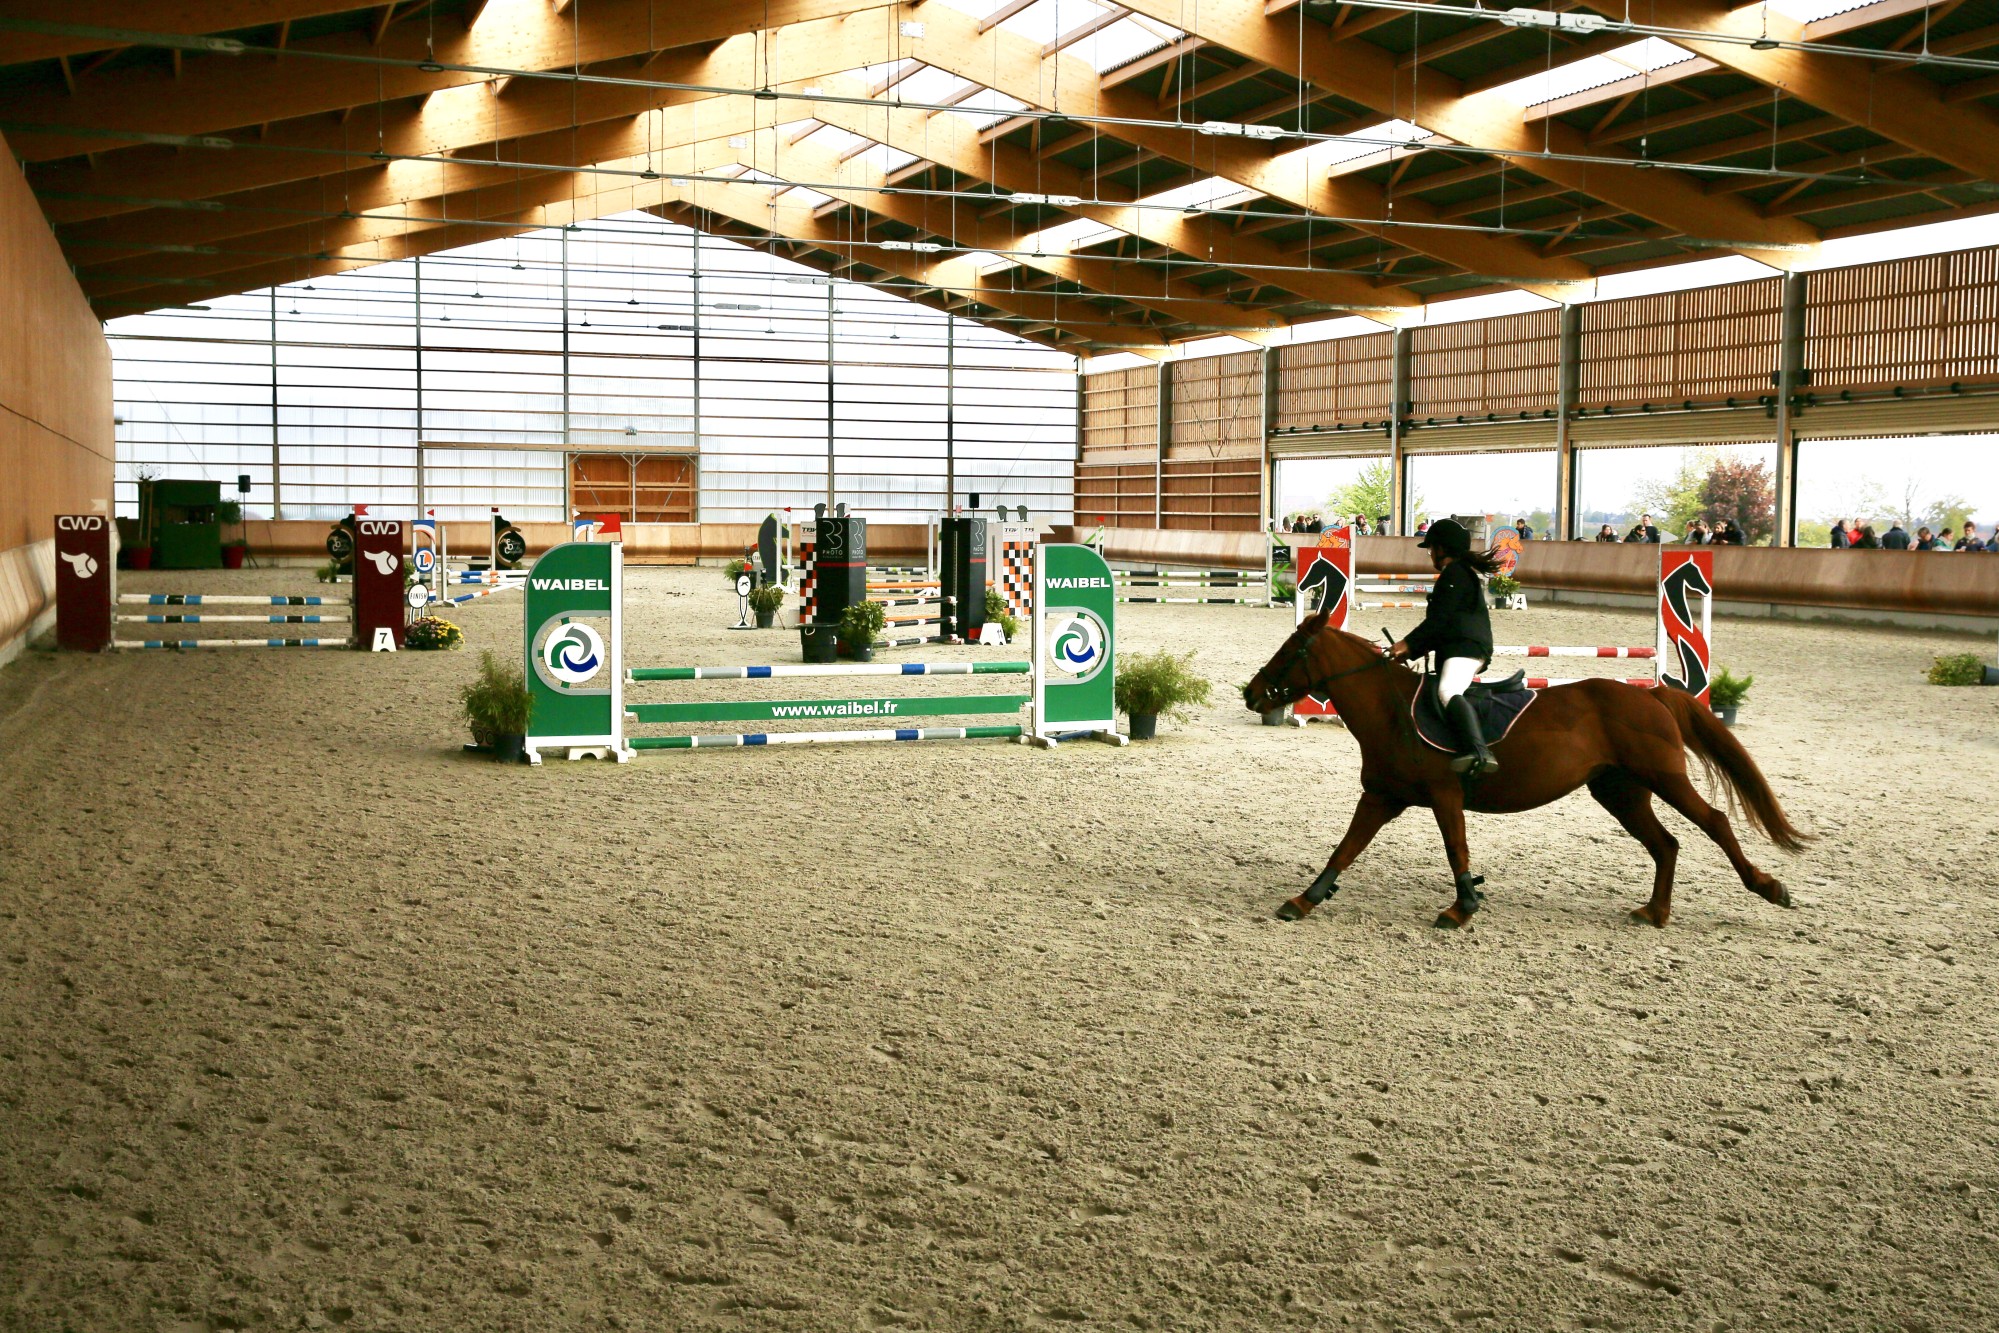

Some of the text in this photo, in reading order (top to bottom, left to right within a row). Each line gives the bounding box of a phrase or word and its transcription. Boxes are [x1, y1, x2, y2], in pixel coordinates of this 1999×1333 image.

[58, 516, 102, 530] CWD
[360, 521, 400, 535] CWD
[531, 578, 610, 591] WAIBEL
[1045, 577, 1111, 589] WAIBEL
[409, 592, 428, 600] FINISH
[1516, 597, 1523, 605] 4
[379, 632, 388, 645] 7
[771, 700, 898, 717] www.waibel.fr
